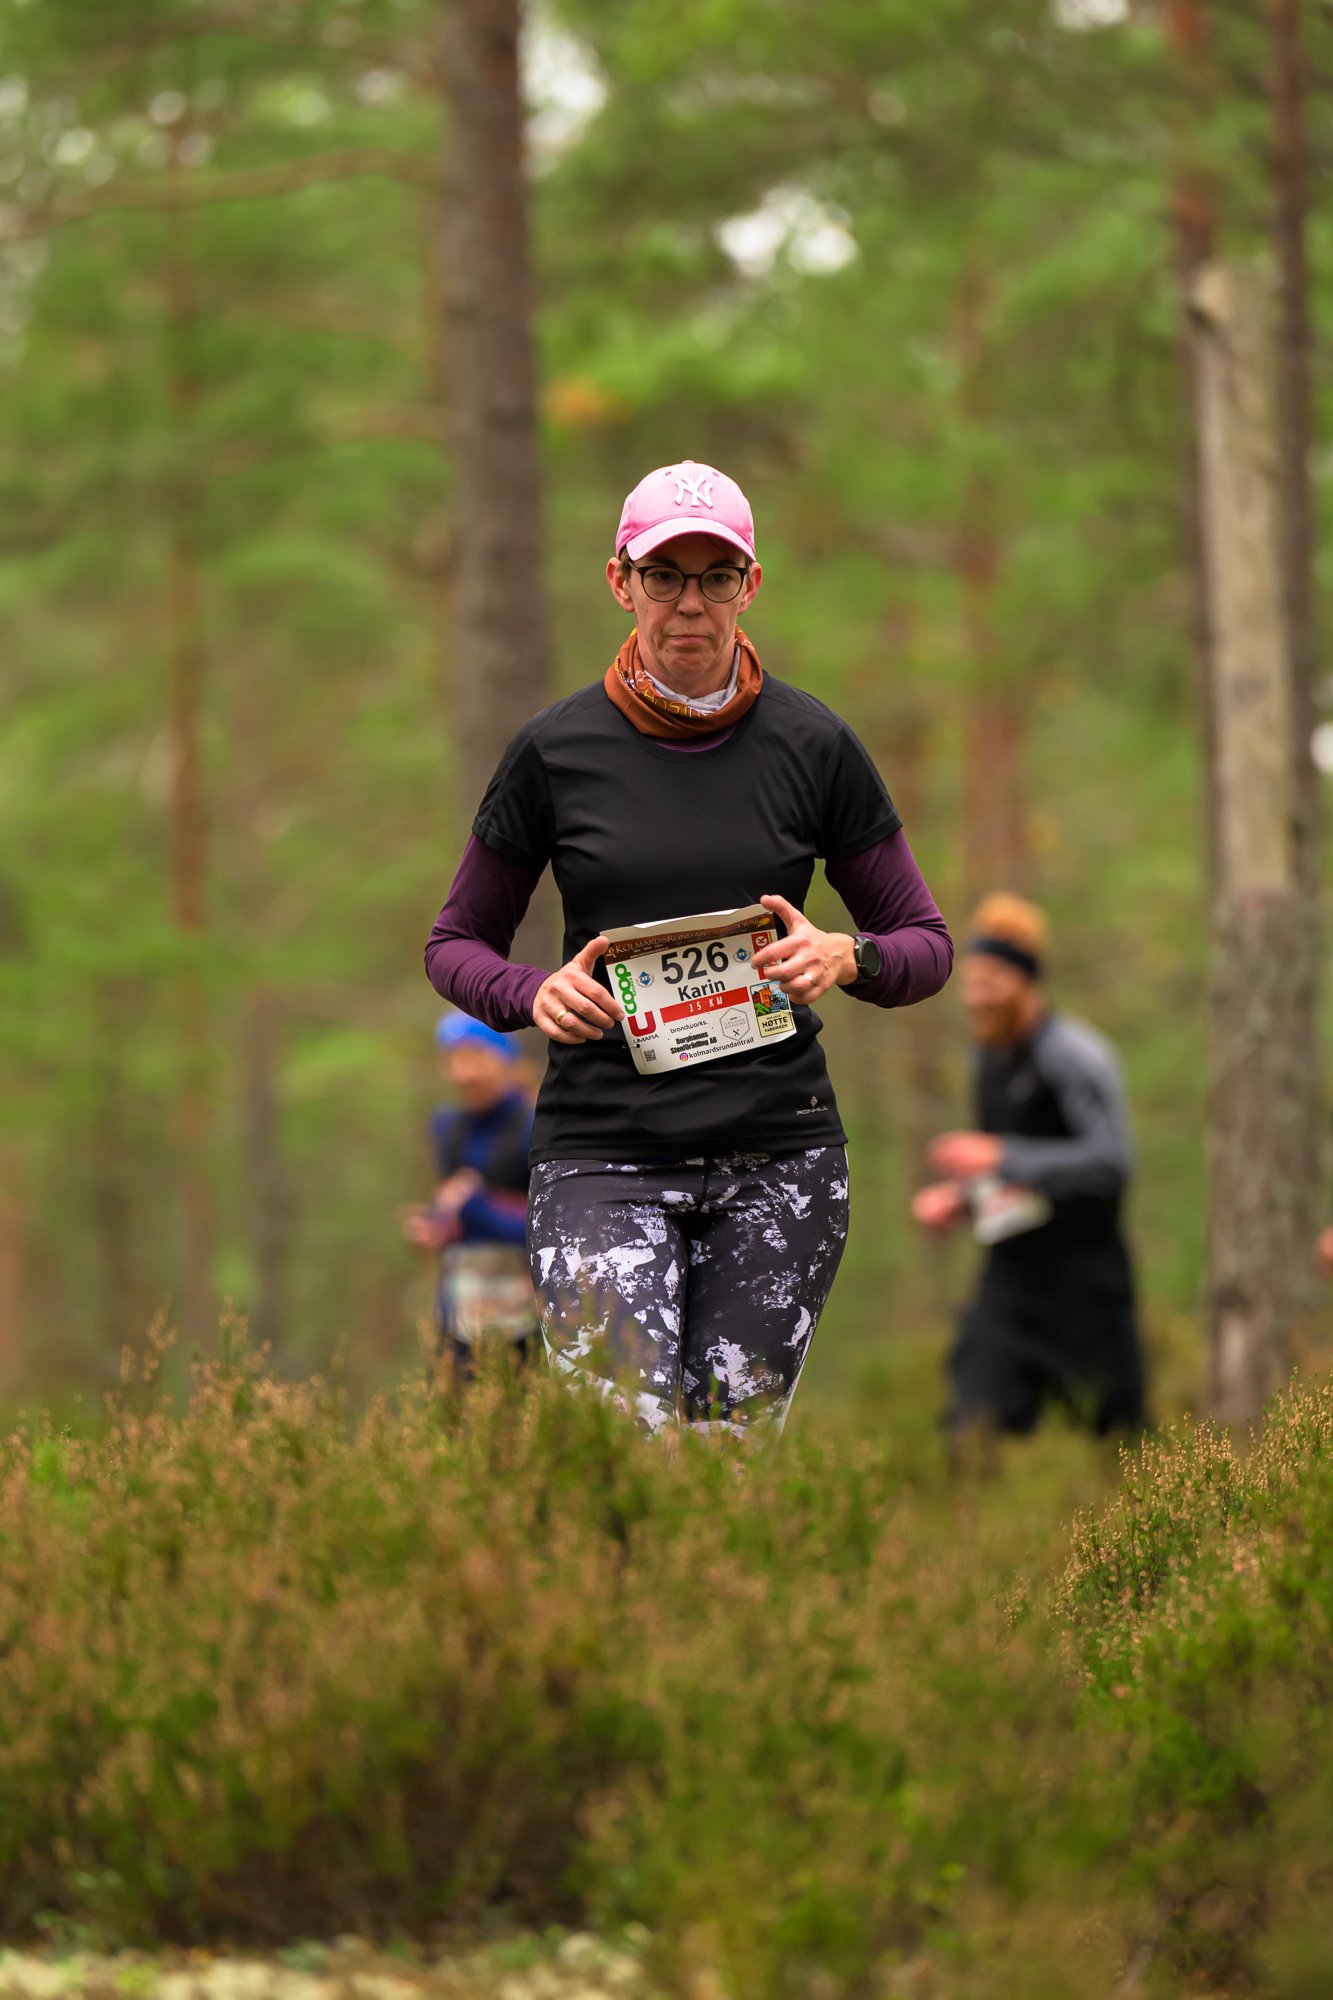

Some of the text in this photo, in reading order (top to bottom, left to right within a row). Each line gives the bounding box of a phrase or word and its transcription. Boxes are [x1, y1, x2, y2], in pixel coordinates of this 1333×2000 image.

[674, 475, 714, 509] NY
[661, 941, 729, 985] 526
[677, 979, 726, 1002] Karin
[689, 996, 723, 1013] 15 KM
[633, 1033, 660, 1045] UMARA
